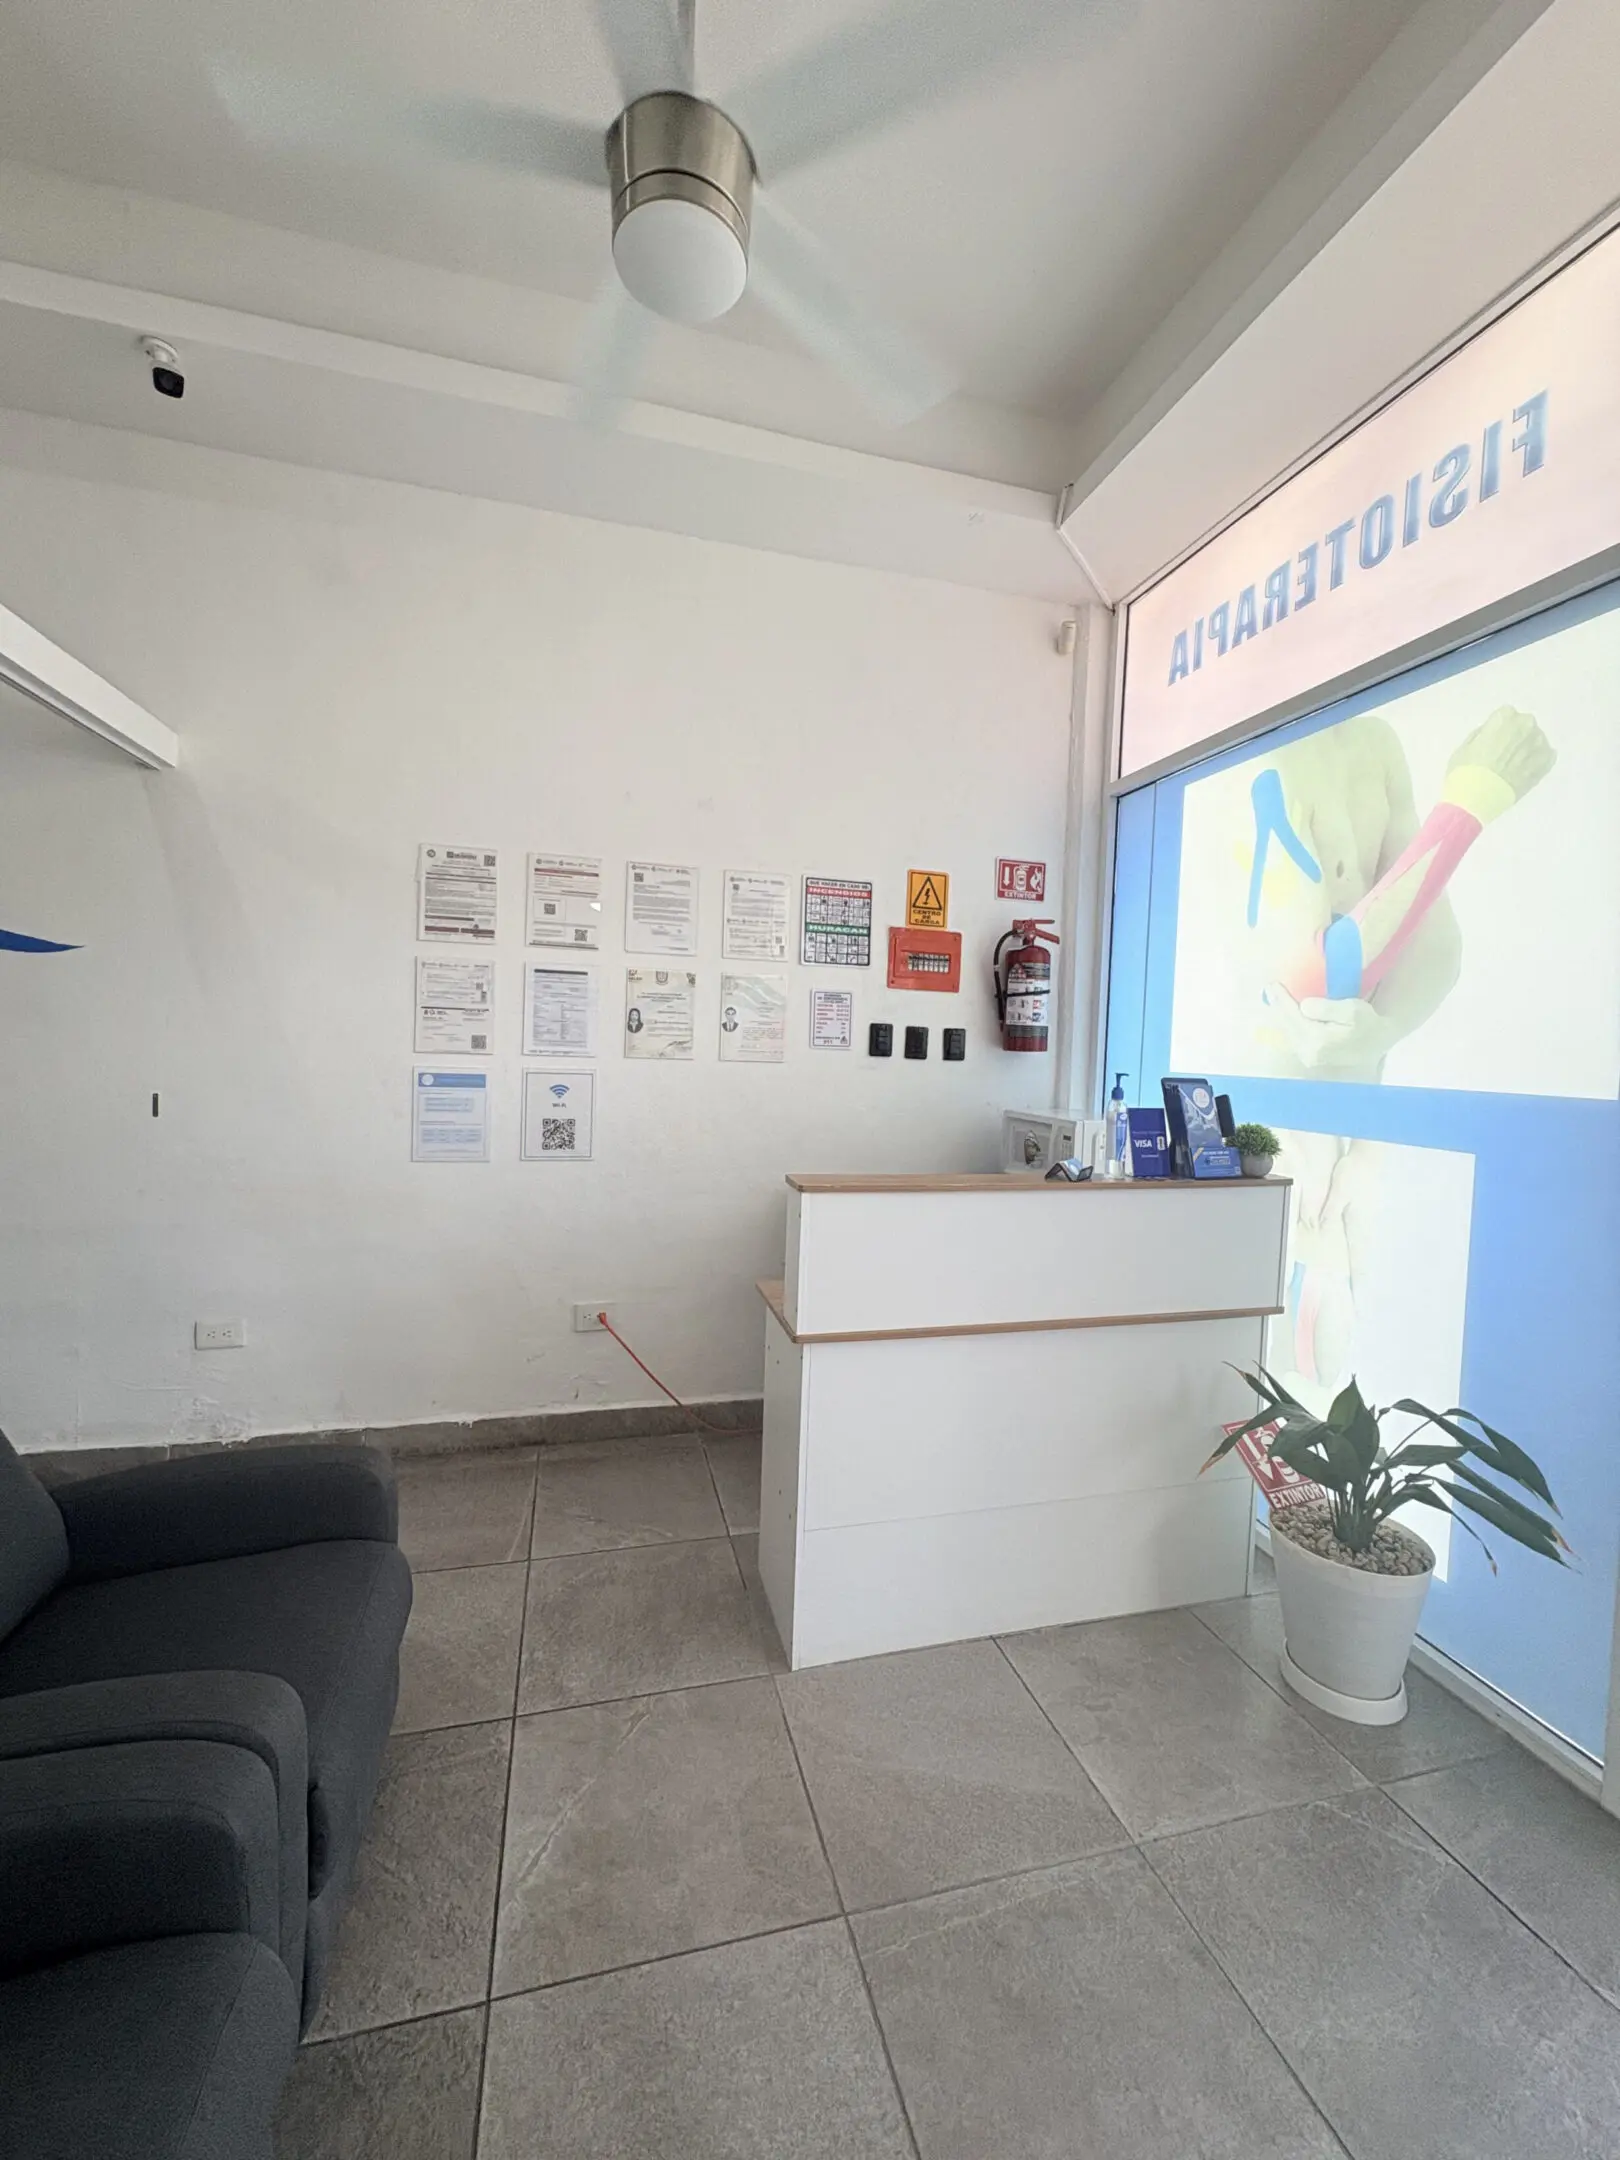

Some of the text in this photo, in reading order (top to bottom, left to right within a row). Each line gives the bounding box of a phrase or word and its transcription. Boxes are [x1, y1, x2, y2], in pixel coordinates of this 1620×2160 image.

[809, 887, 868, 896] INCENDIOS
[1004, 890, 1037, 900] EXTINTOR
[809, 925, 868, 934] HURACAN
[1133, 1139, 1153, 1148] VISA
[1269, 1482, 1325, 1509] EXTINTOR
